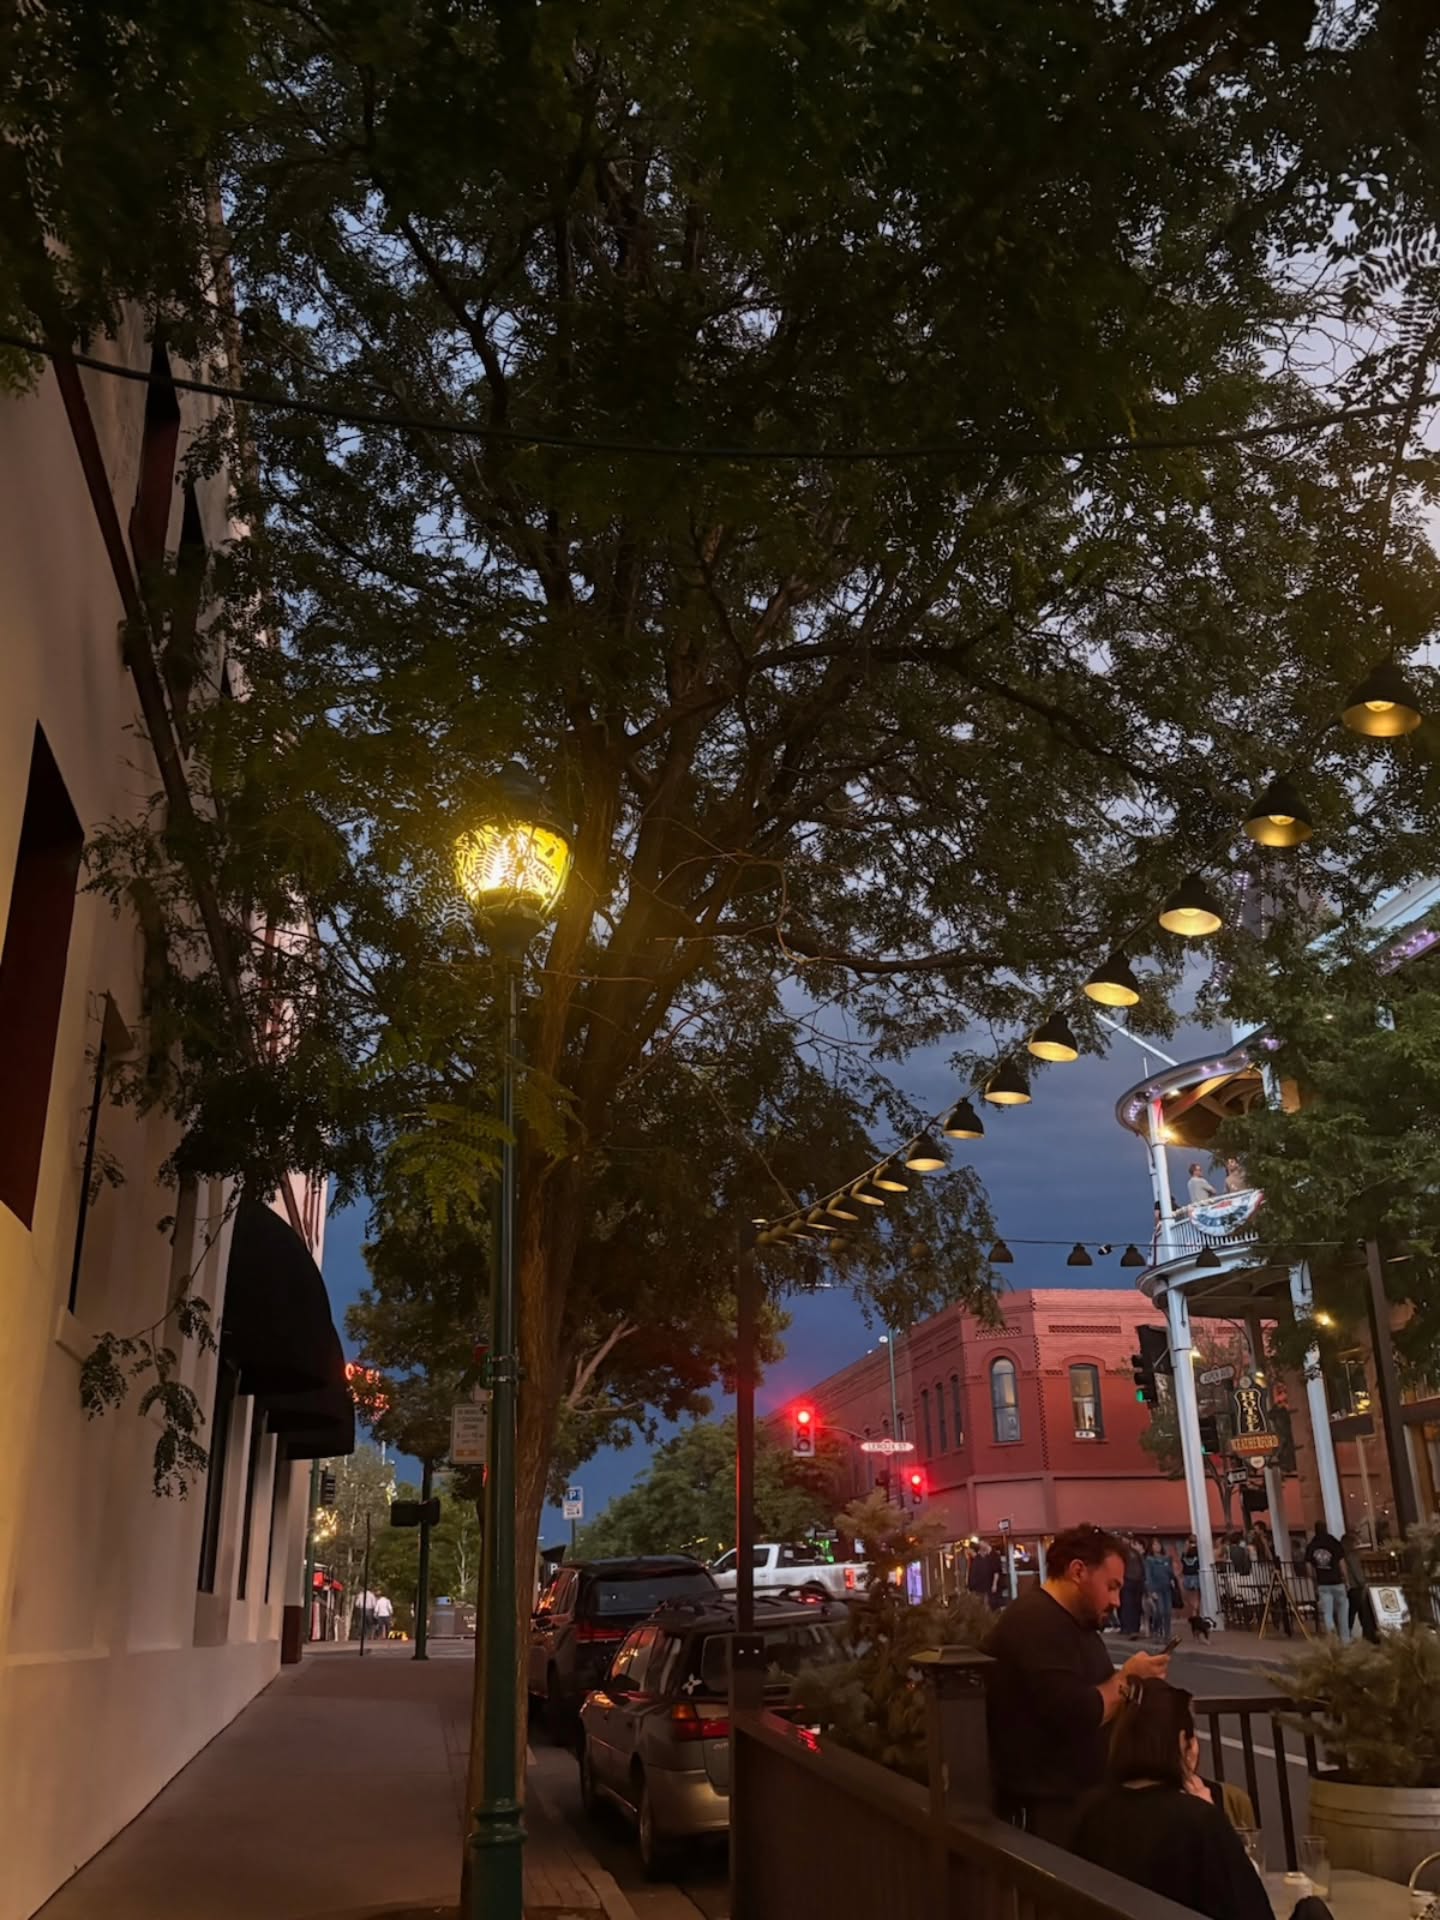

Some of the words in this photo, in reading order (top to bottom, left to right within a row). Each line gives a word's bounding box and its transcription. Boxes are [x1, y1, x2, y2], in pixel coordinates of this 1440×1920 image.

[1203, 1369, 1220, 1382] ASPEN
[1241, 1391, 1261, 1432] HOTEL
[1231, 1434, 1279, 1451] WEATHERFORD
